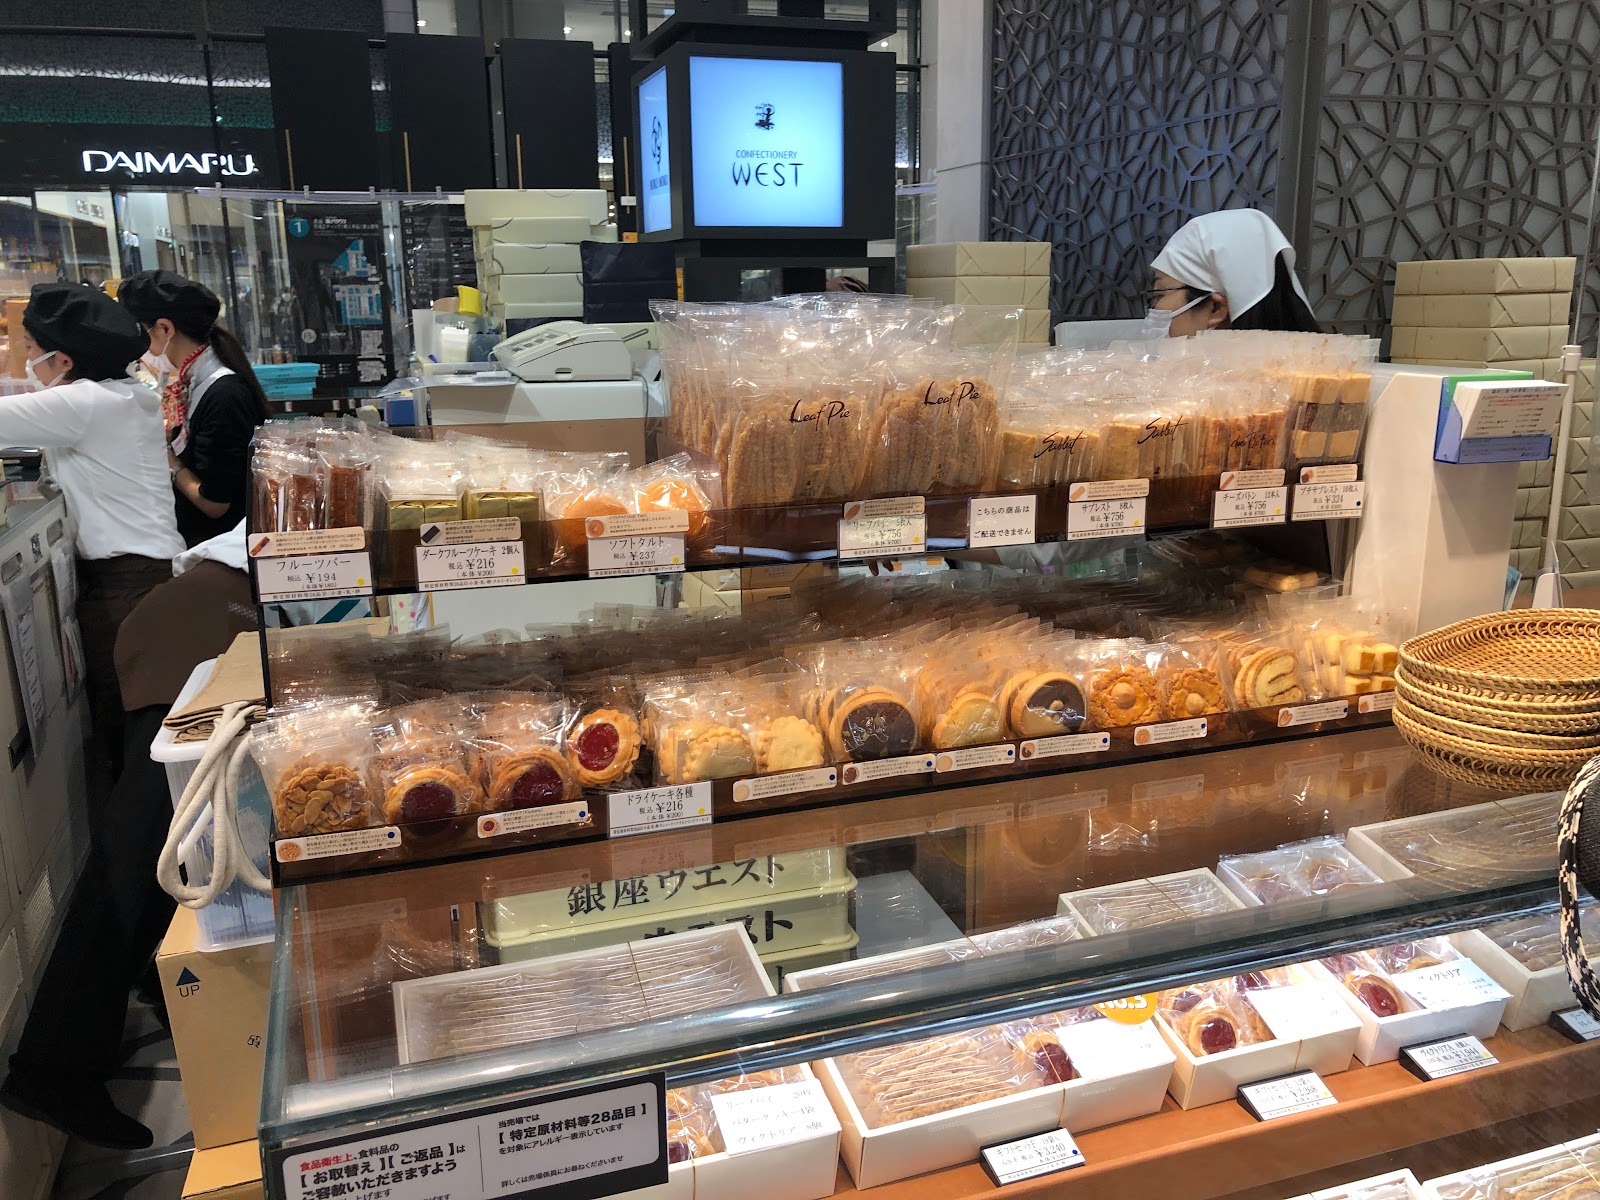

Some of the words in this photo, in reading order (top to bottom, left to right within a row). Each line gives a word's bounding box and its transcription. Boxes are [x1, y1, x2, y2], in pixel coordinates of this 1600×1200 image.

[735, 149, 799, 160] CONFECTIONERY
[82, 150, 257, 176] DAIMARU
[732, 162, 804, 188] WEST
[294, 221, 302, 233] 1
[923, 380, 958, 413] Leaf
[957, 381, 981, 408] Pie
[788, 399, 827, 432] Leaf
[827, 400, 850, 425] Pie
[977, 506, 1030, 516] こちらの商品は
[1081, 502, 1111, 513] サブレスト
[1247, 501, 1267, 510] ¥756
[1103, 511, 1125, 522] ¥756
[878, 529, 902, 539] ¥756
[974, 528, 1032, 539] ご配送できません
[609, 535, 664, 550] ソフトタルト
[422, 545, 497, 560] ダークフルーツケーキ
[501, 545, 520, 555] 2個入
[630, 551, 656, 561] ¥237
[276, 557, 351, 573] フルーツバー
[448, 562, 464, 570] 税込
[466, 558, 495, 570] ¥216
[305, 573, 337, 583] ¥194
[627, 785, 694, 806] ドライケーキ各種
[639, 806, 654, 815] 税込
[655, 799, 684, 813] ¥216
[566, 854, 785, 918] 銀座ウエスト
[178, 984, 200, 998] UP
[498, 1113, 540, 1129] 当売場では
[499, 1123, 624, 1155] を対象にアレルギー表示しています
[300, 1143, 400, 1172] 食品衛生上、食料品の
[501, 1155, 624, 1188] 詳しくは売場係員にお尋ねくださいませ
